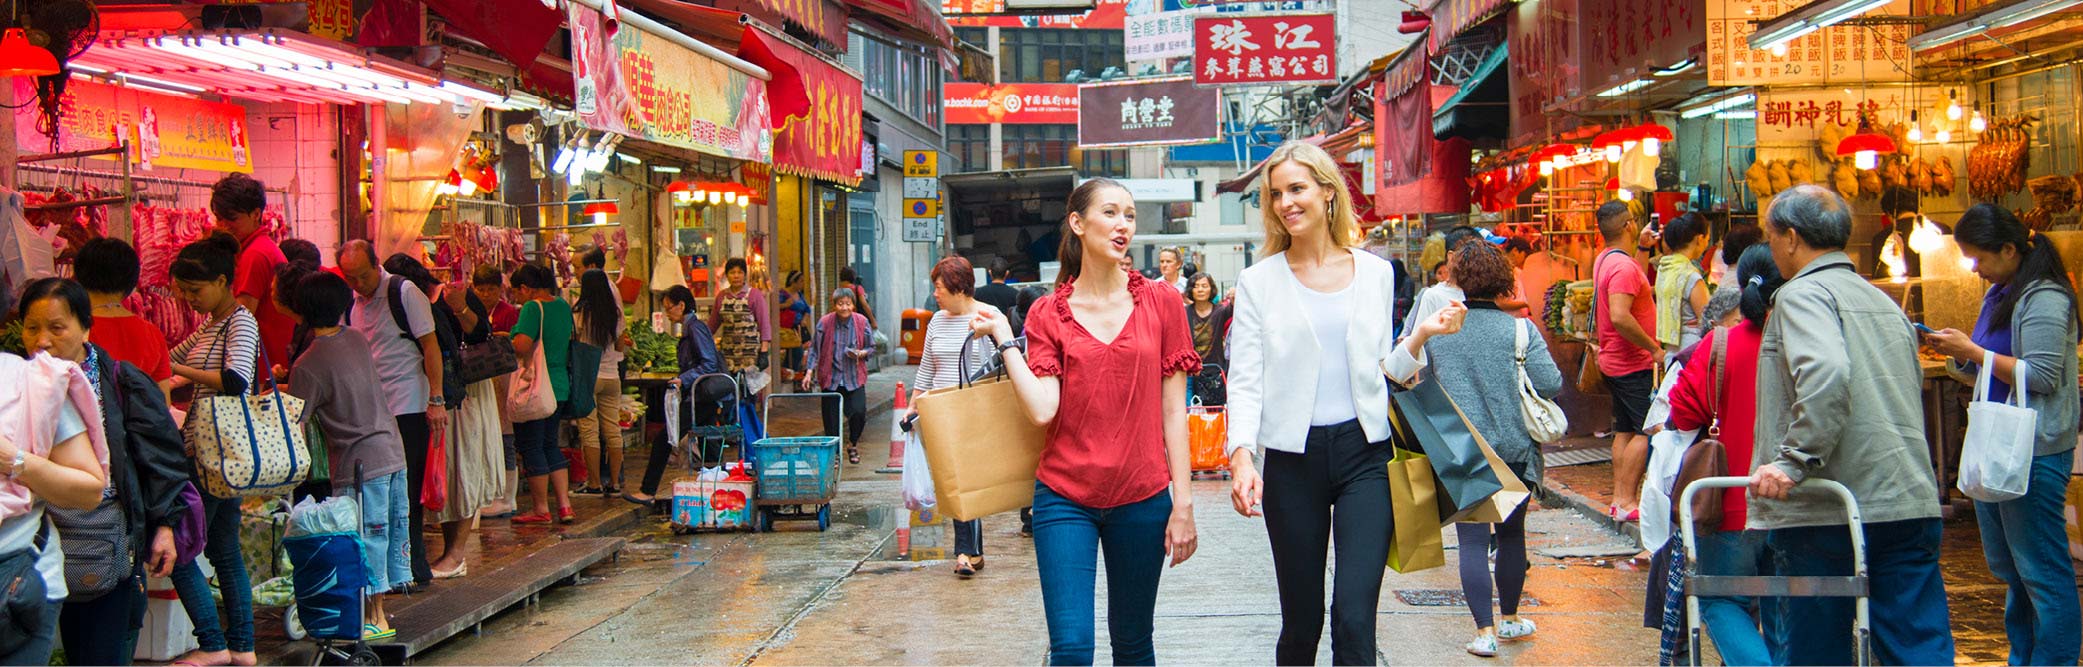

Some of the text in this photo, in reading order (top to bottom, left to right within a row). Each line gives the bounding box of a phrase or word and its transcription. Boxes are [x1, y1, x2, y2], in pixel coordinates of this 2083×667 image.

[1209, 19, 1321, 55] 珠江
[1204, 54, 1328, 80] 參茸燕窩公司
[1785, 63, 1801, 75] 20
[912, 220, 928, 228] End
